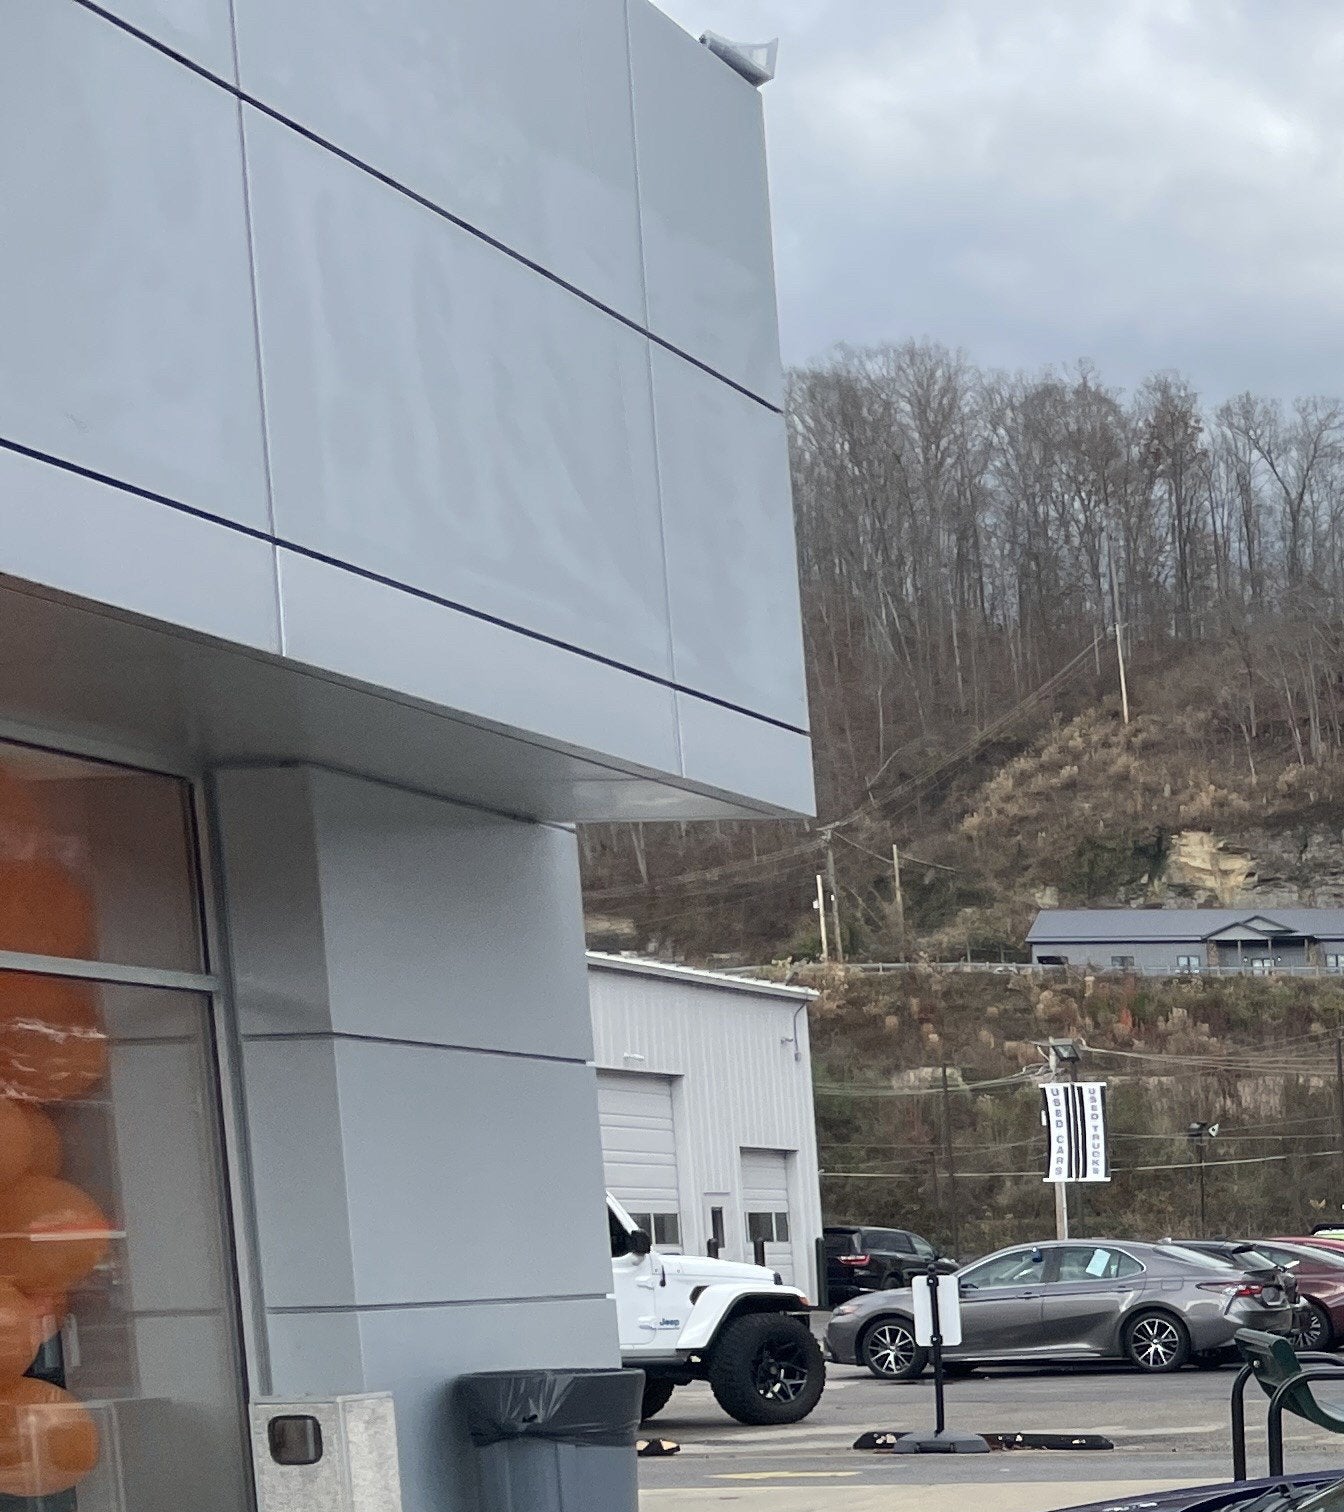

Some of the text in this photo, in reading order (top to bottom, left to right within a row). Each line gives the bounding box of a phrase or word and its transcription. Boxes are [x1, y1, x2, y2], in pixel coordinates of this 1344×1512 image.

[1051, 1088, 1064, 1175] USED CARS
[1088, 1088, 1100, 1174] USED TRUCKS
